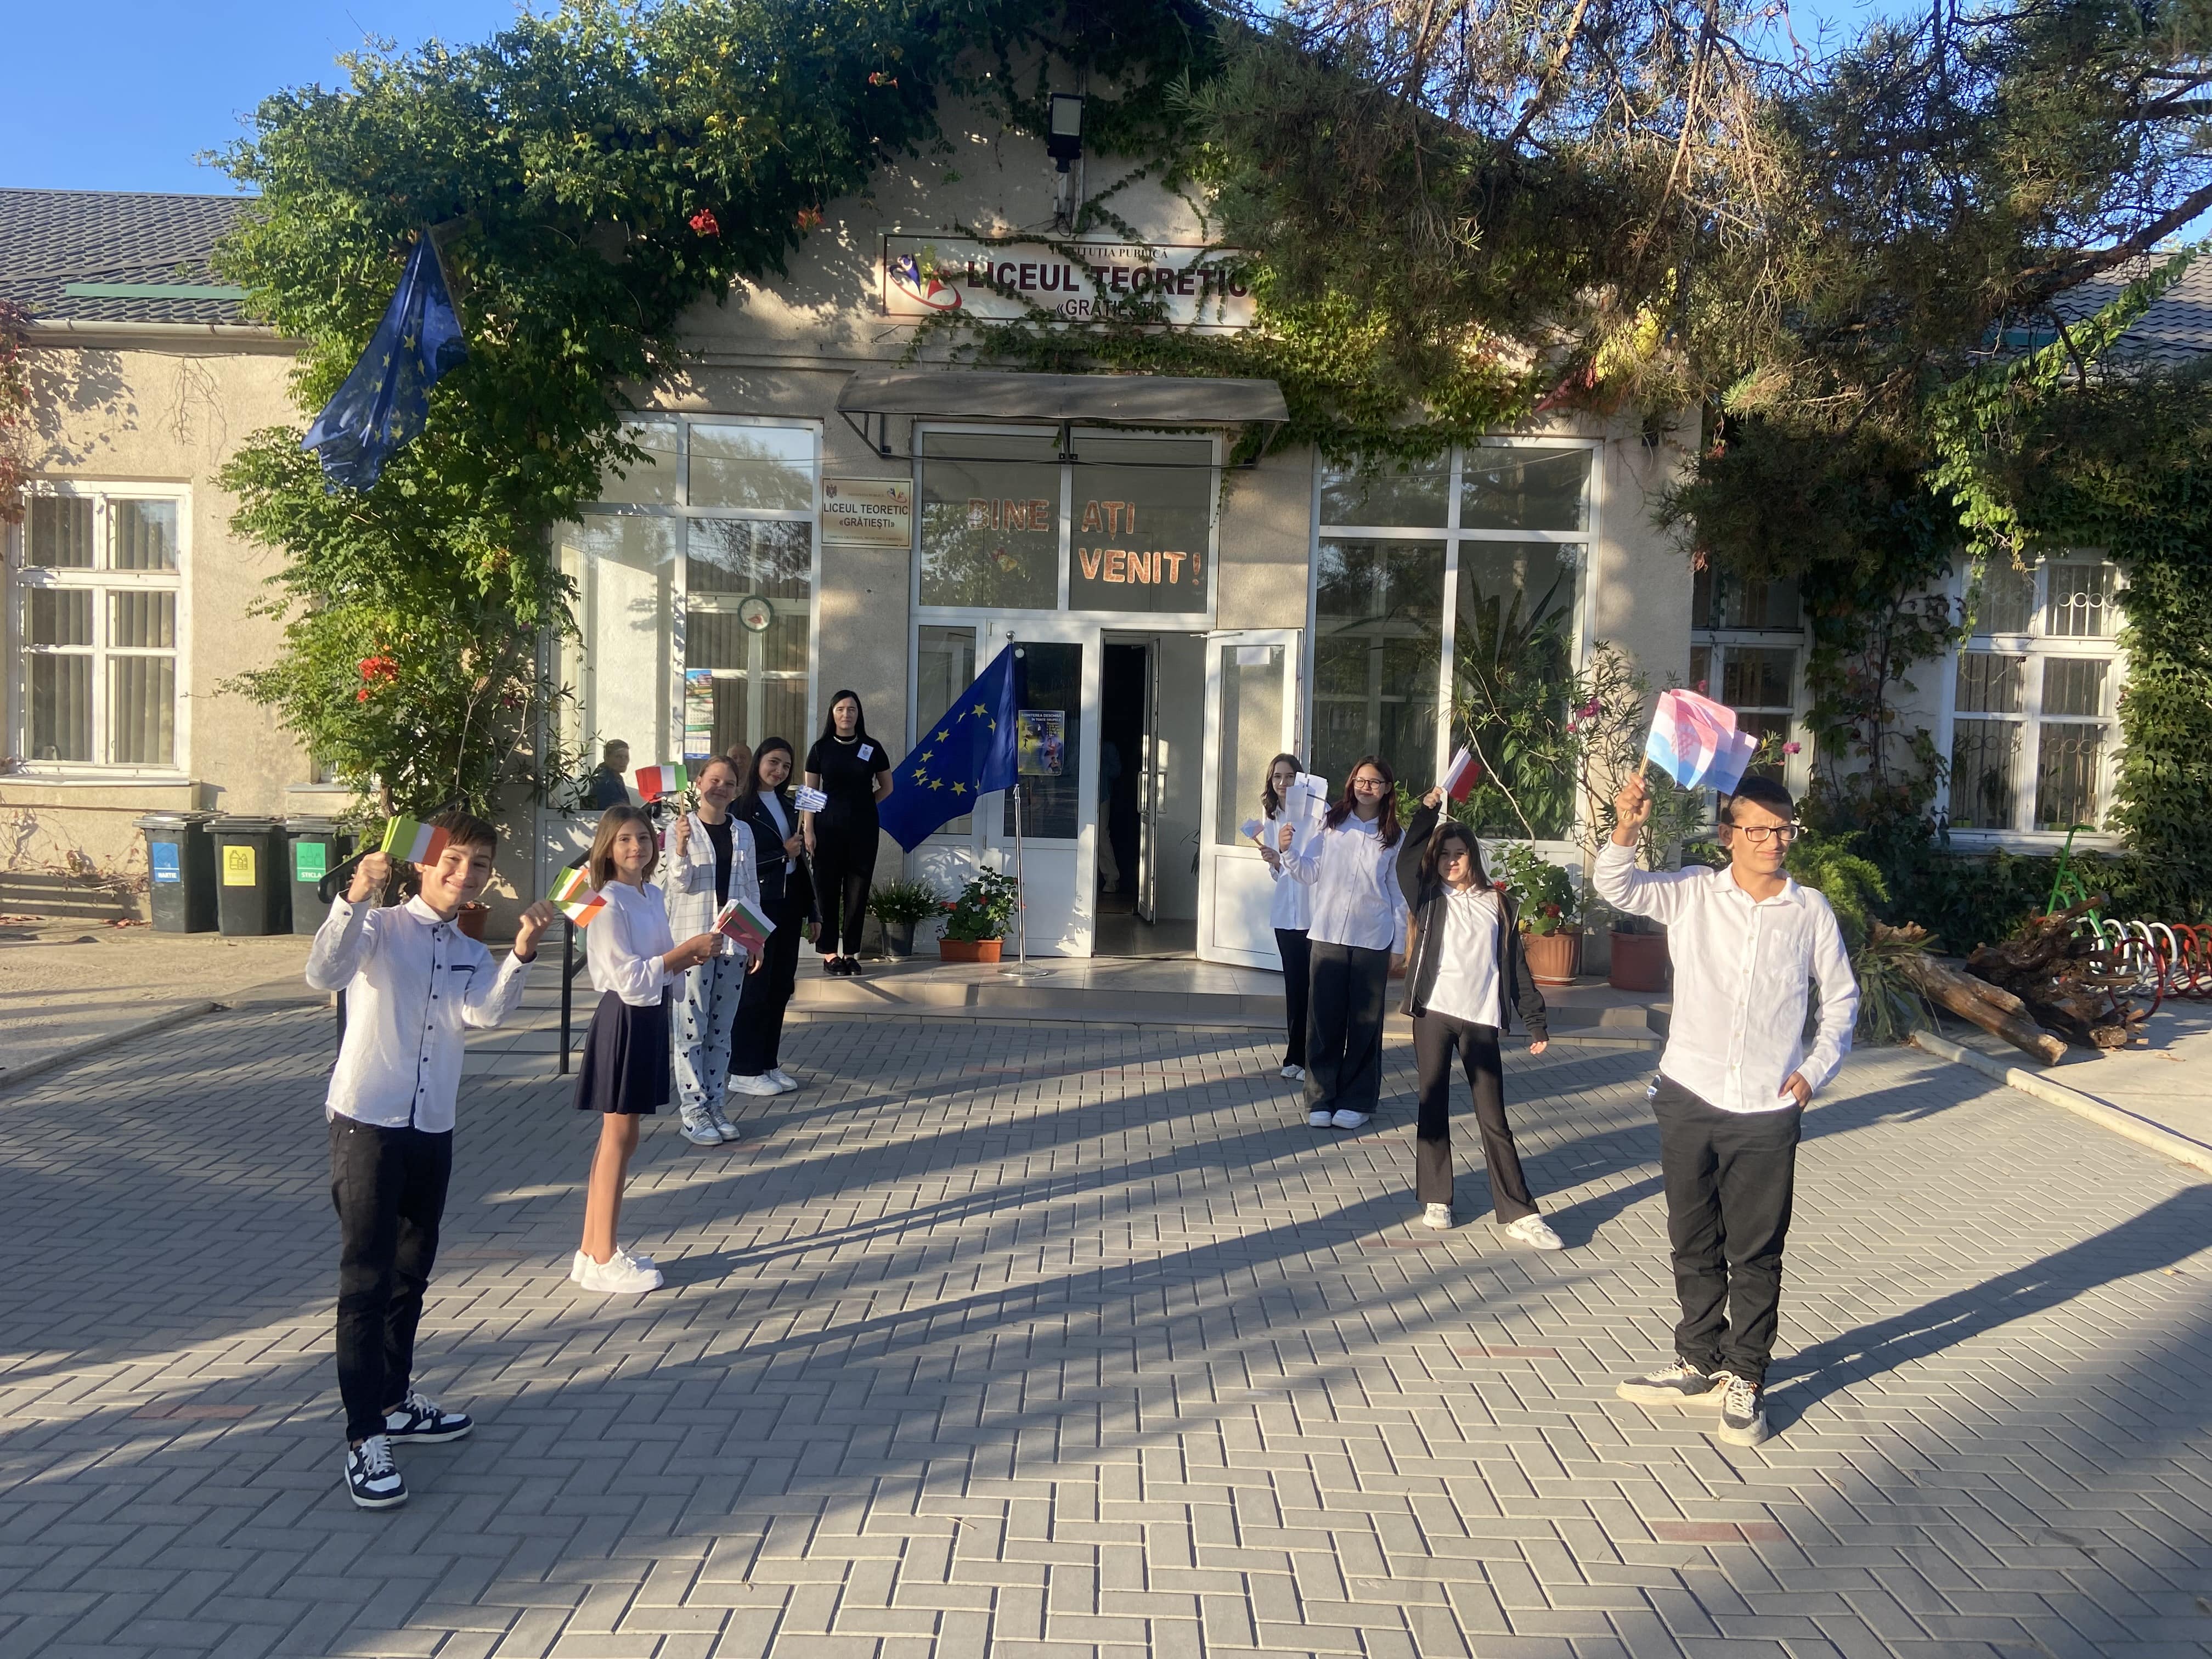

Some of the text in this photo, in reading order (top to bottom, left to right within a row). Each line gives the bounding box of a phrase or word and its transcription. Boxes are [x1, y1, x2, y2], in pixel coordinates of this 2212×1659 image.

[1119, 248, 1168, 259] PUBLICĂ
[967, 261, 1080, 292] LICEUL
[823, 503, 909, 515] LICEUL TEORETIC
[967, 498, 1050, 532] BINE
